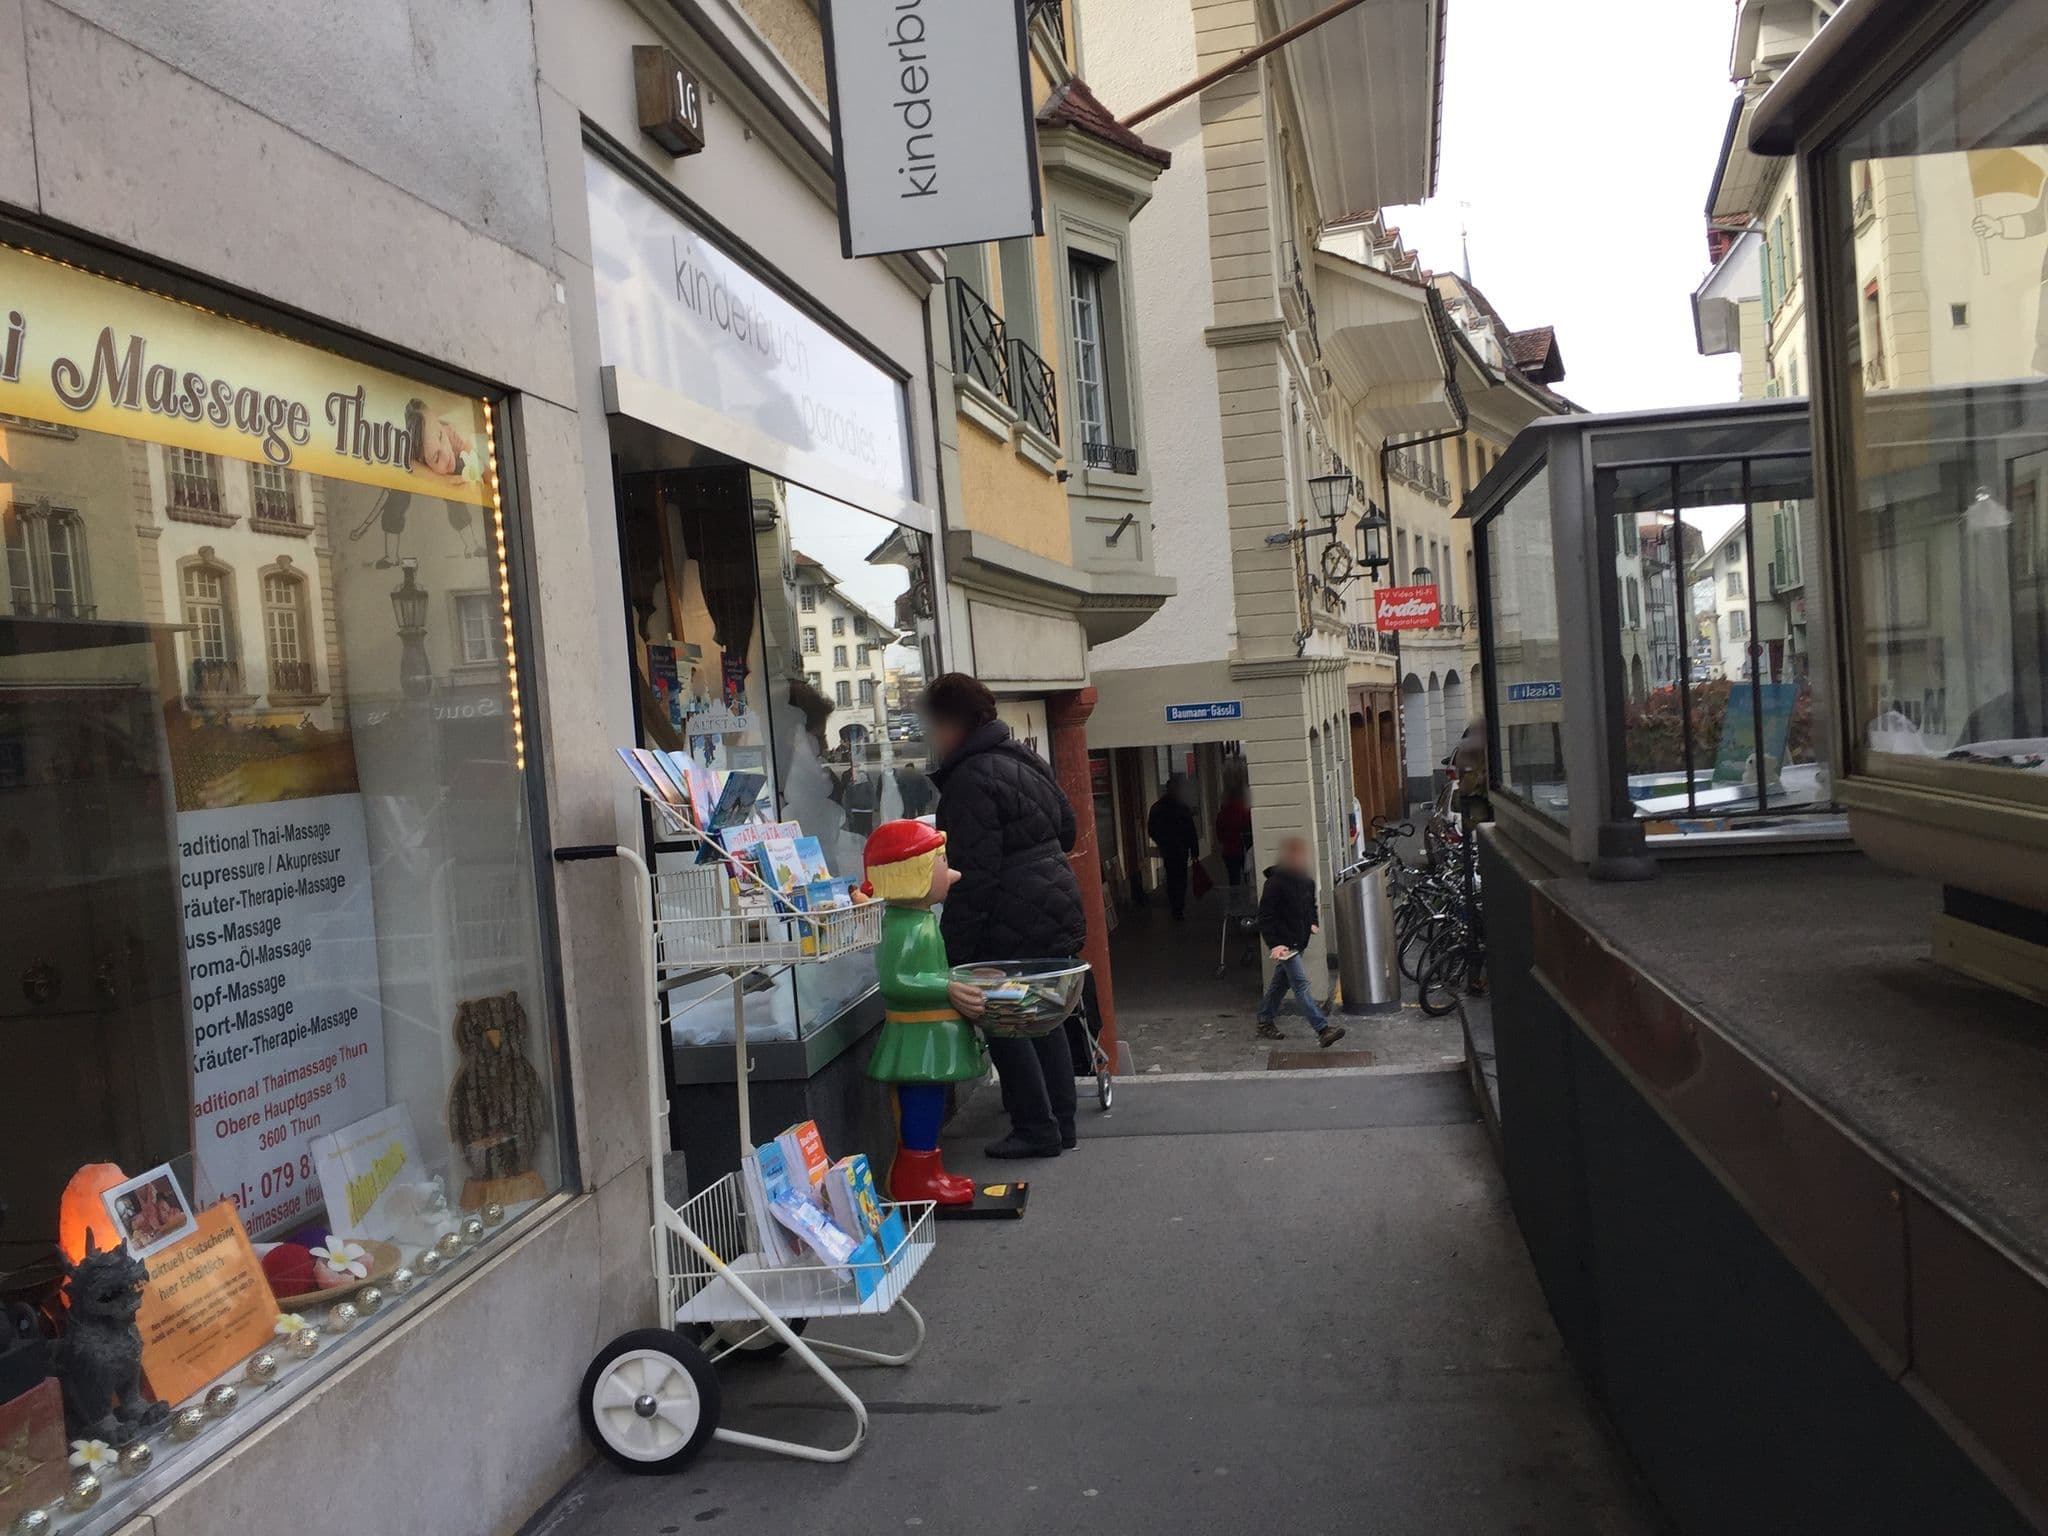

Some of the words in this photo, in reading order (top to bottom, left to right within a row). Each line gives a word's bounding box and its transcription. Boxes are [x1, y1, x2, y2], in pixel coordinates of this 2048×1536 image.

[676, 70, 698, 129] 16
[671, 234, 811, 384] kinderbuch
[0, 309, 26, 382] i
[50, 325, 311, 466] Massage
[325, 384, 414, 475] Thun
[1379, 592, 1390, 600] TV
[1392, 590, 1414, 598] Video
[1172, 704, 1235, 719] Baumann-Gässli
[252, 821, 331, 846] Thai-Massage
[181, 860, 265, 889] cupressure
[276, 847, 341, 873] Akupressur
[184, 874, 346, 919] räuter-Therapie-Massage
[185, 916, 282, 950] uss-Massage
[190, 936, 312, 980] roma-Öl-Massage
[193, 972, 286, 1013] opf-Massage
[195, 1000, 294, 1046] port-Massage
[263, 1053, 338, 1092] Thaimassage
[339, 1041, 368, 1062] Thun
[215, 1108, 261, 1139] Obere
[264, 1083, 332, 1122] Hauptgasse
[335, 1072, 347, 1091] 18
[258, 1124, 287, 1151] 3600
[290, 1113, 321, 1137] Thun
[260, 1162, 295, 1199] 079
[299, 1151, 317, 1180] 8
[158, 1282, 179, 1302] hier
